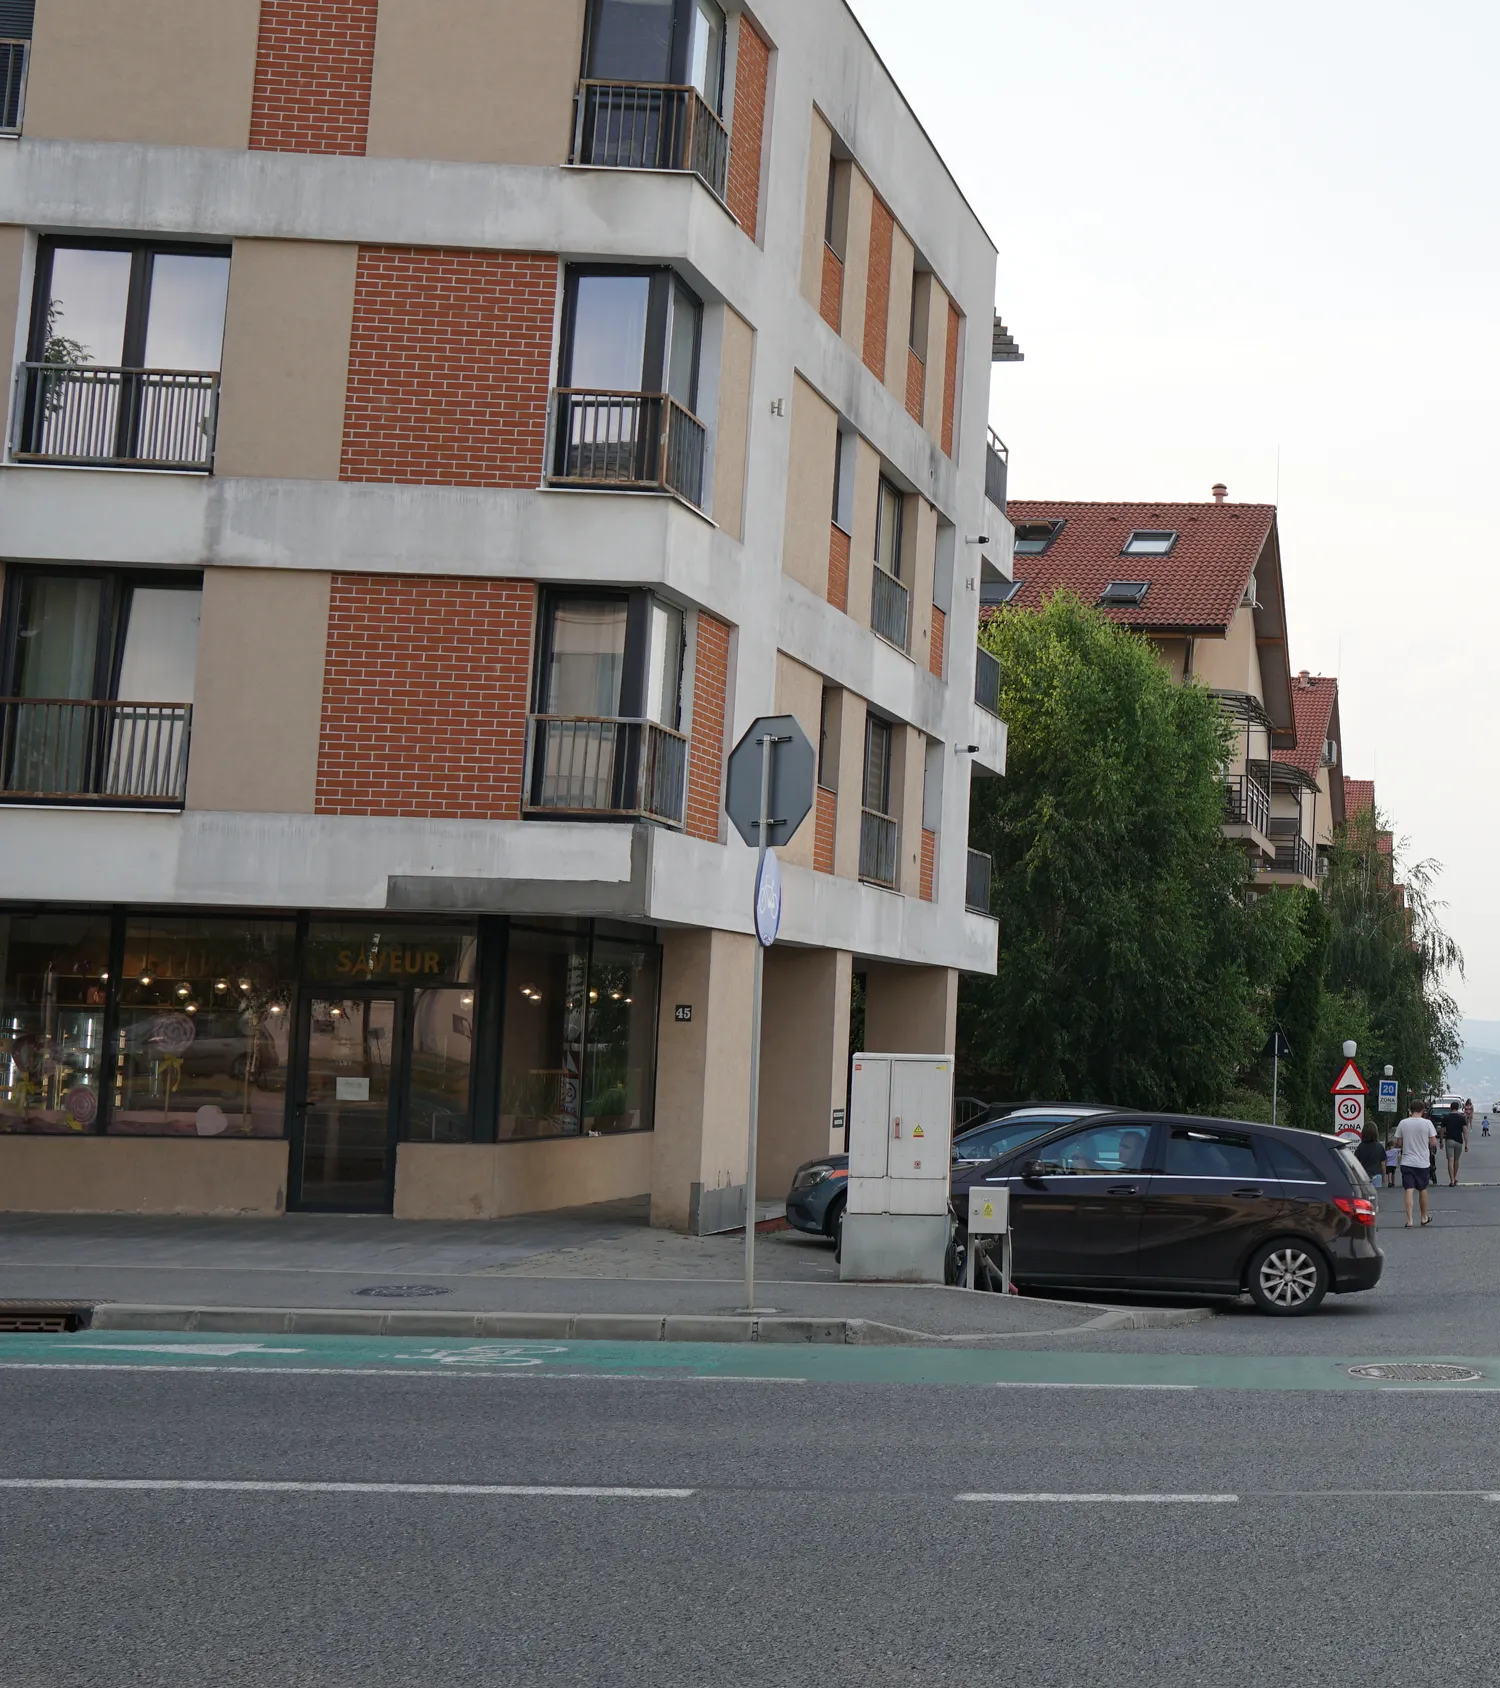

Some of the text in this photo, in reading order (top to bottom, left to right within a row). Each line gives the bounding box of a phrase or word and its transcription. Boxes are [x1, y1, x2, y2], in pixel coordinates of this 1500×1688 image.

[337, 941, 440, 976] SAVEUR
[676, 1007, 691, 1019] 45
[1382, 1085, 1394, 1093] 20
[1342, 1103, 1357, 1114] 30
